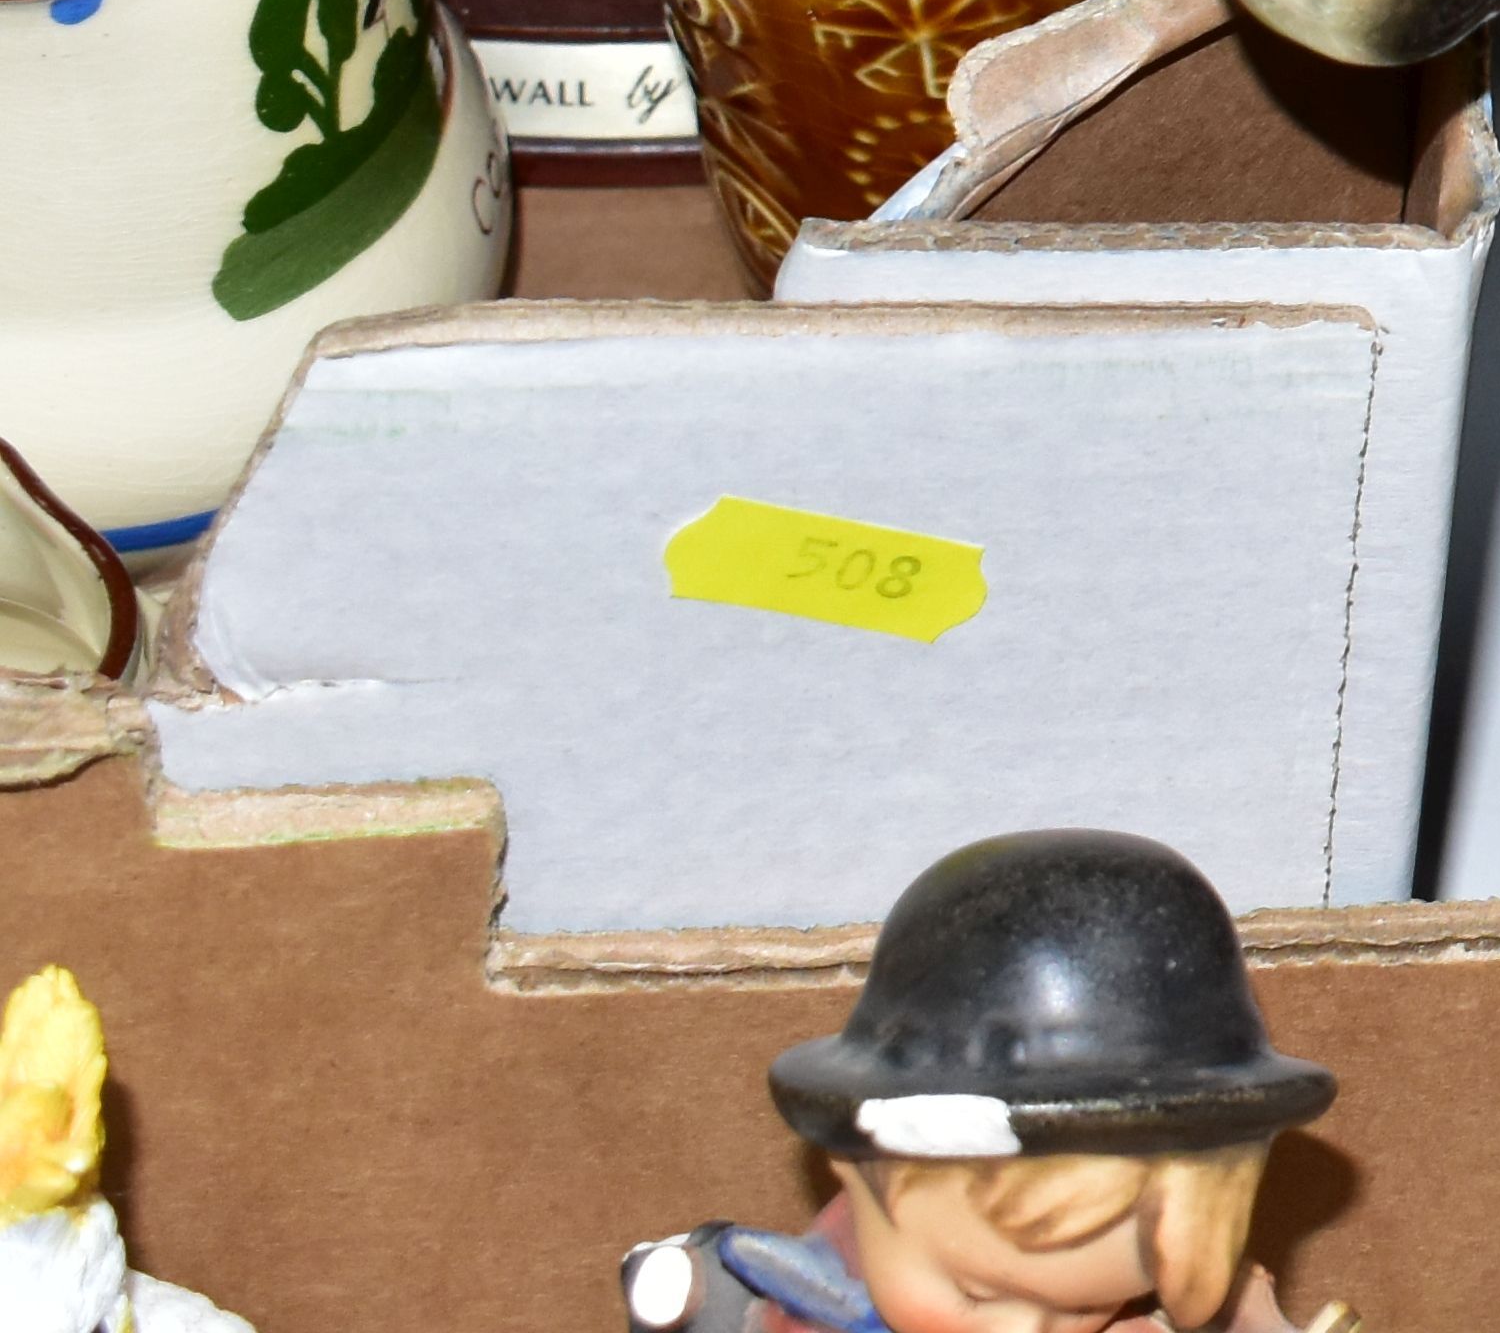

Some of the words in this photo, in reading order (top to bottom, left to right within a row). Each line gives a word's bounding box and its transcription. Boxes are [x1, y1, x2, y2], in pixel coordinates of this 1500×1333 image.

[490, 76, 596, 107] WALL
[626, 64, 677, 124] by
[787, 536, 922, 599] 508
